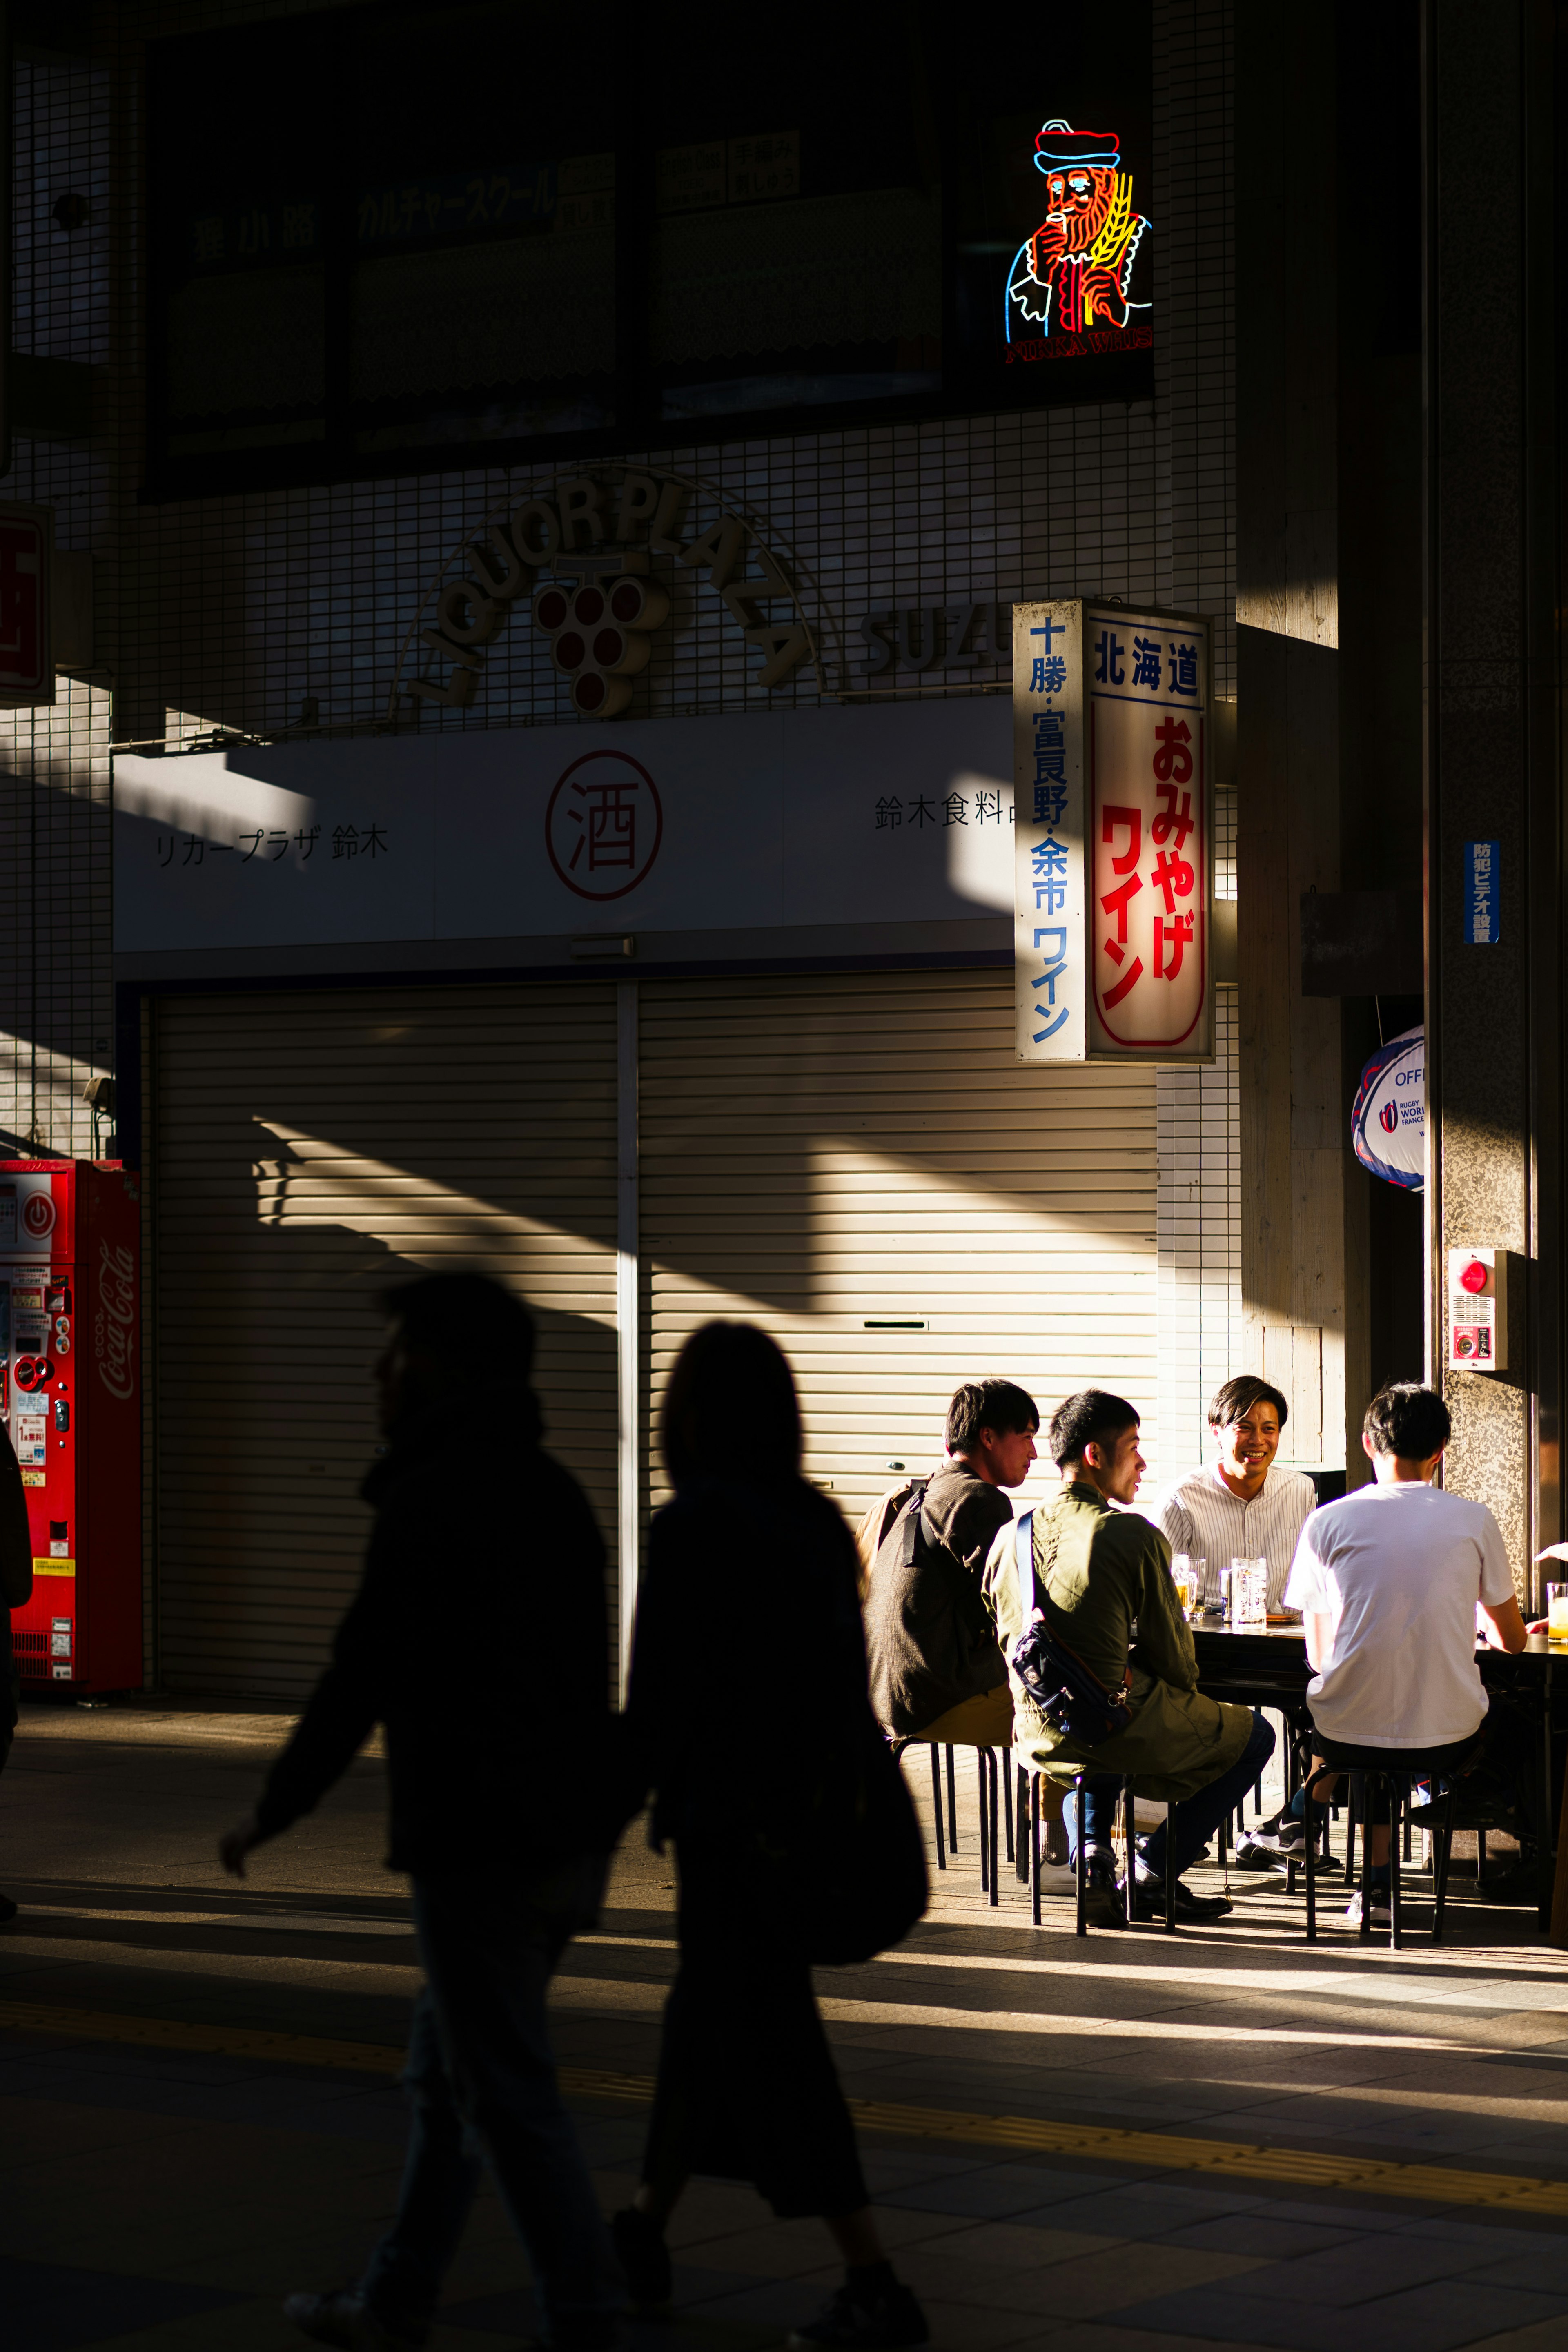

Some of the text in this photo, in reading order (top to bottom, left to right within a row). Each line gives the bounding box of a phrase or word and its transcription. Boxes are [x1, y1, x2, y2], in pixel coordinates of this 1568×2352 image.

[660, 148, 721, 177] English Class
[735, 139, 793, 165] 手編み
[357, 167, 555, 240] カルチャースクール
[1003, 333, 1087, 365] NIKKA
[406, 474, 814, 709] LIQUOR PLAZA
[1094, 631, 1198, 697] 北海道
[566, 781, 640, 873] 酒
[875, 789, 1015, 830] 鈴木食料
[157, 822, 389, 869] リカープラザ 鈴木
[1151, 716, 1195, 981] おみやげ
[1100, 805, 1144, 1011] ワイン
[1472, 843, 1491, 943] 防犯ビデオ設置
[1031, 927, 1069, 1043] ワイン
[1400, 1100, 1419, 1109] RUGBY
[1402, 1116, 1424, 1126] FRANCE
[98, 1235, 134, 1401] Coca-Cola
